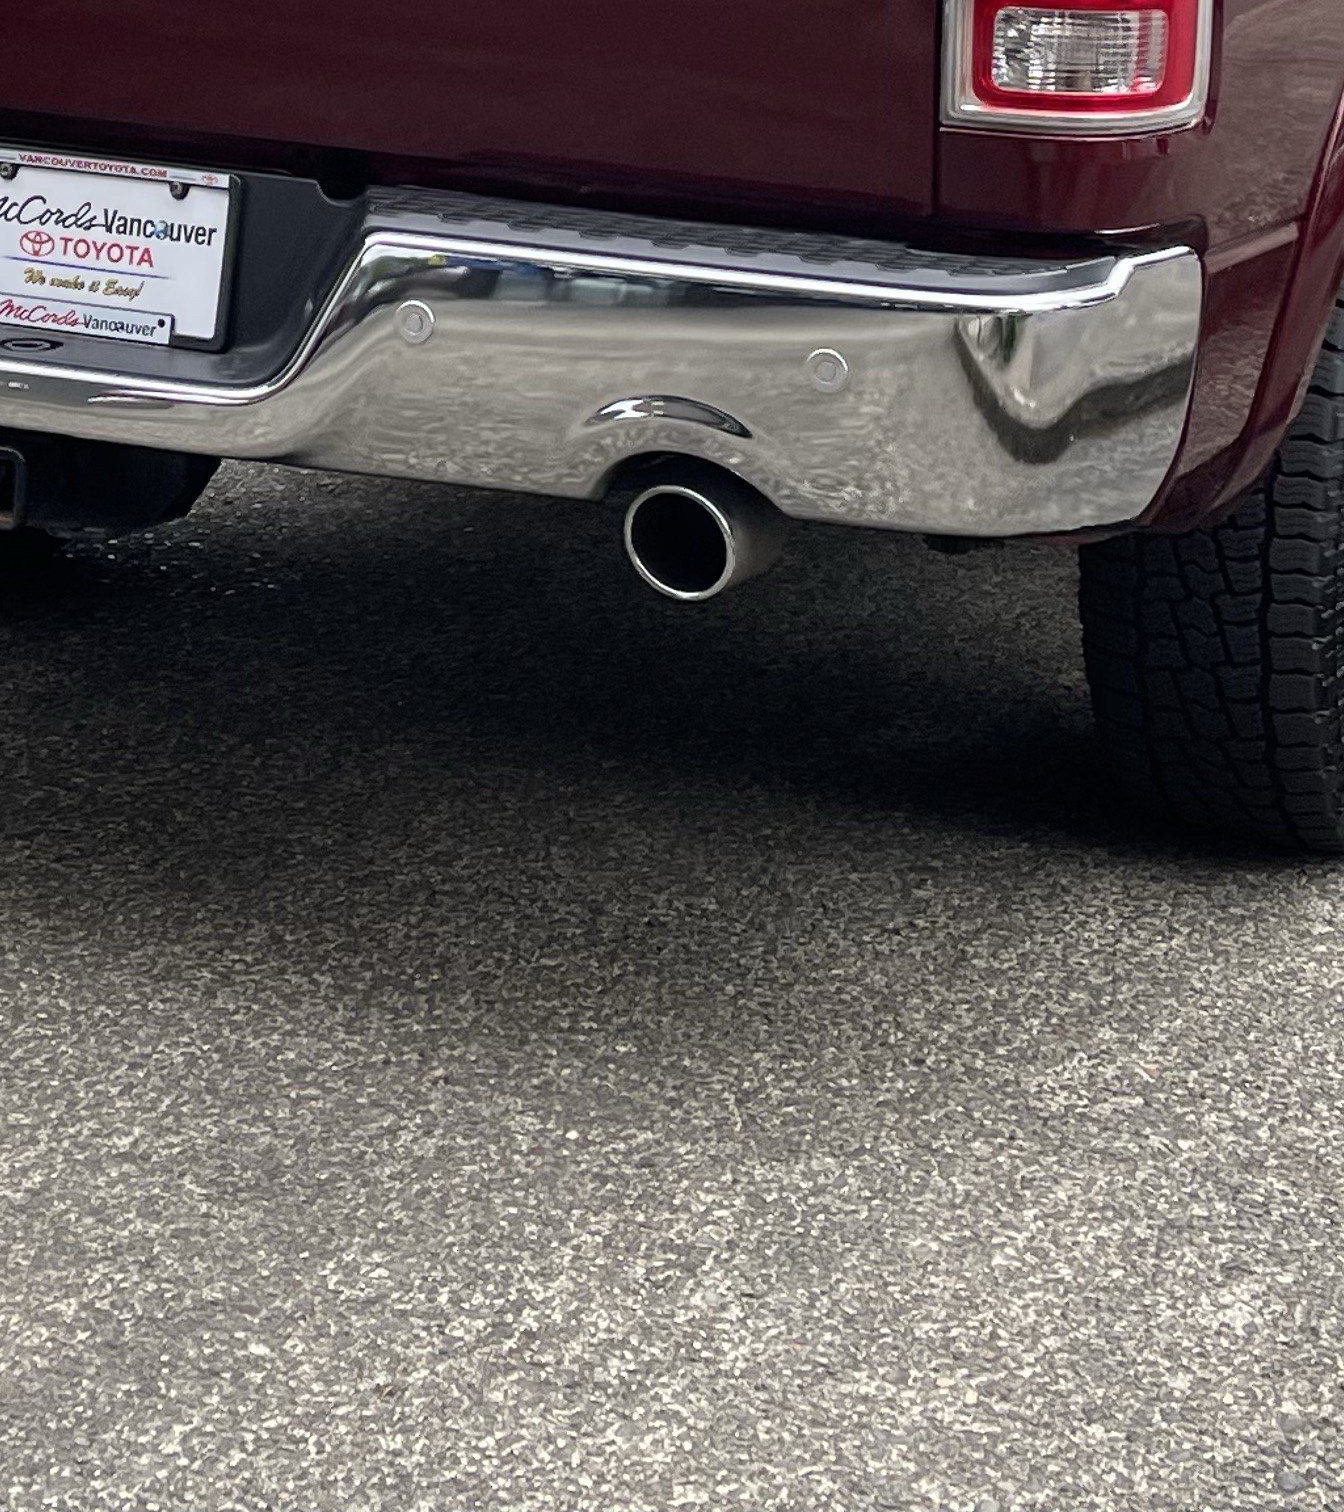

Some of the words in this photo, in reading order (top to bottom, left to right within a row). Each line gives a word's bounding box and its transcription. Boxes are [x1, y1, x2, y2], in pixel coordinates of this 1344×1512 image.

[19, 153, 167, 178] VANCOUVERTOYOTA.COM
[103, 208, 218, 246] Vancouver
[60, 237, 154, 268] TOYOTA
[81, 314, 157, 338] Vancouver
